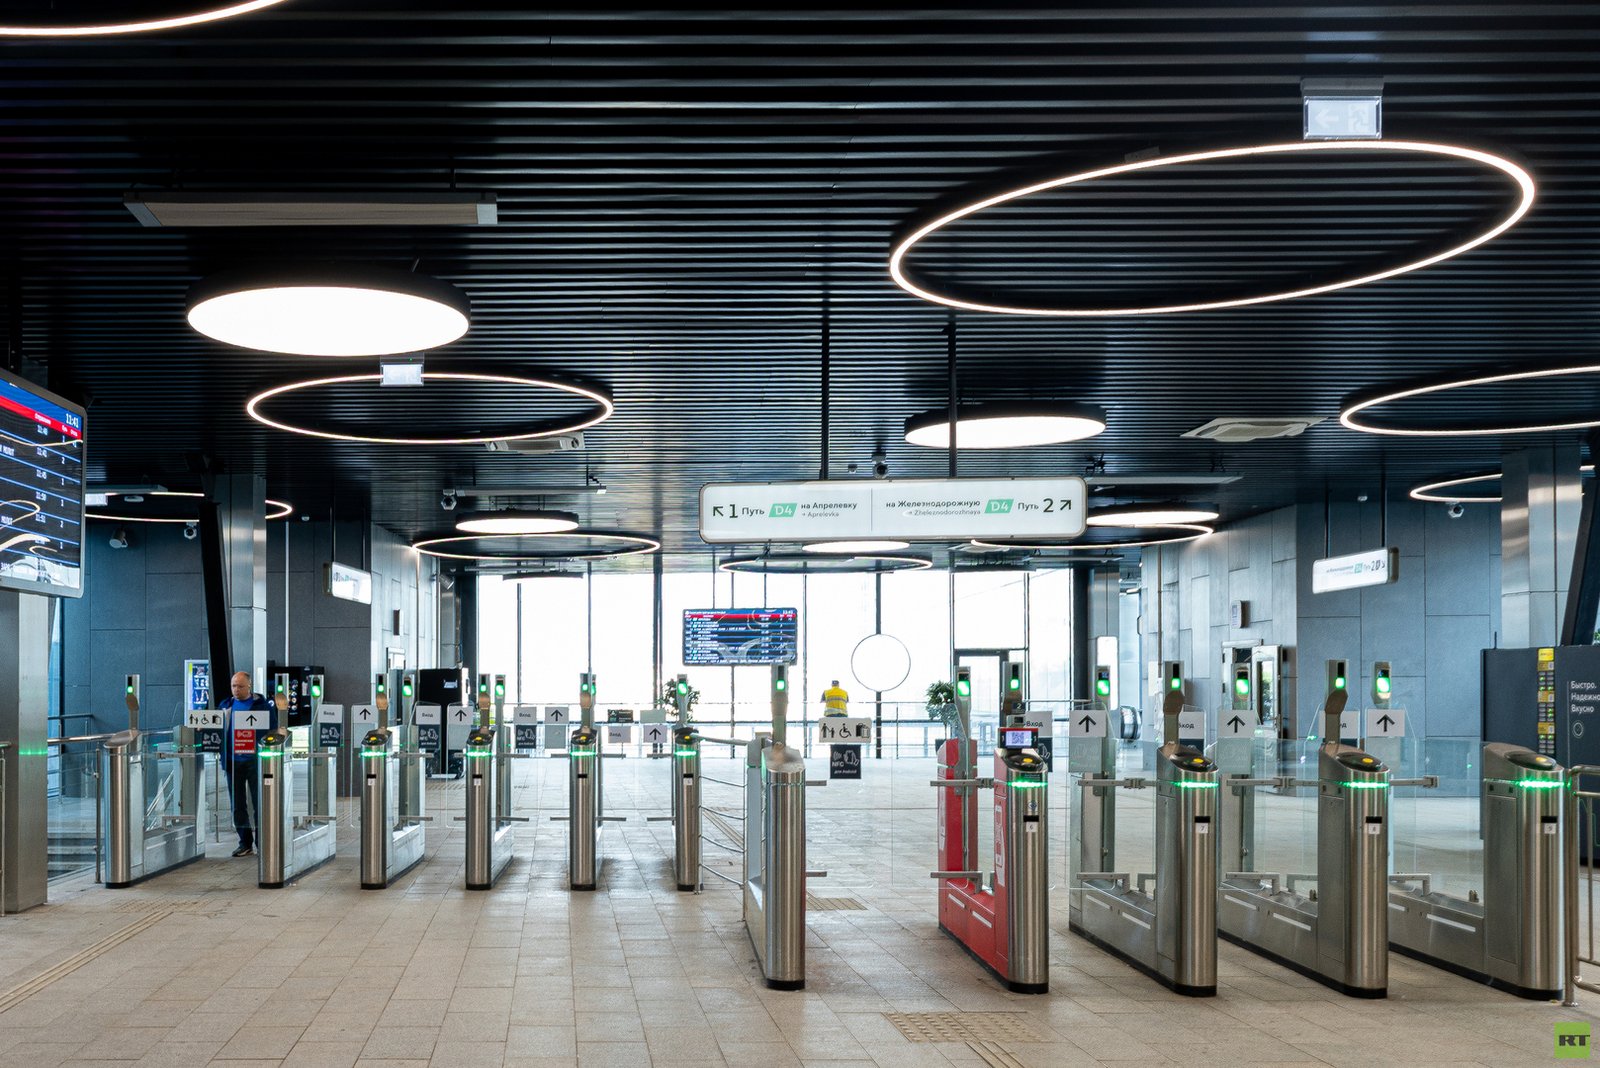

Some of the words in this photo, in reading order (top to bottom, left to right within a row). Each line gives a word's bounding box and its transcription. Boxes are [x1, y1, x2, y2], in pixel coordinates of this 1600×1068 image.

[61, 456, 65, 464] 2
[60, 499, 64, 507] 1
[897, 499, 981, 508] Железнодорожную
[990, 500, 1009, 512] D4
[1018, 502, 1039, 511] Путь
[1043, 498, 1054, 513] 2
[729, 503, 738, 519] 1
[741, 507, 765, 517] Путь
[774, 504, 793, 516] D4
[812, 501, 857, 510] Апрелевку
[914, 508, 981, 516] Zheleznodorozhnaya
[1570, 681, 1597, 690] Быстро.
[1571, 703, 1595, 715] Вкусно
[1026, 720, 1044, 728] Вход
